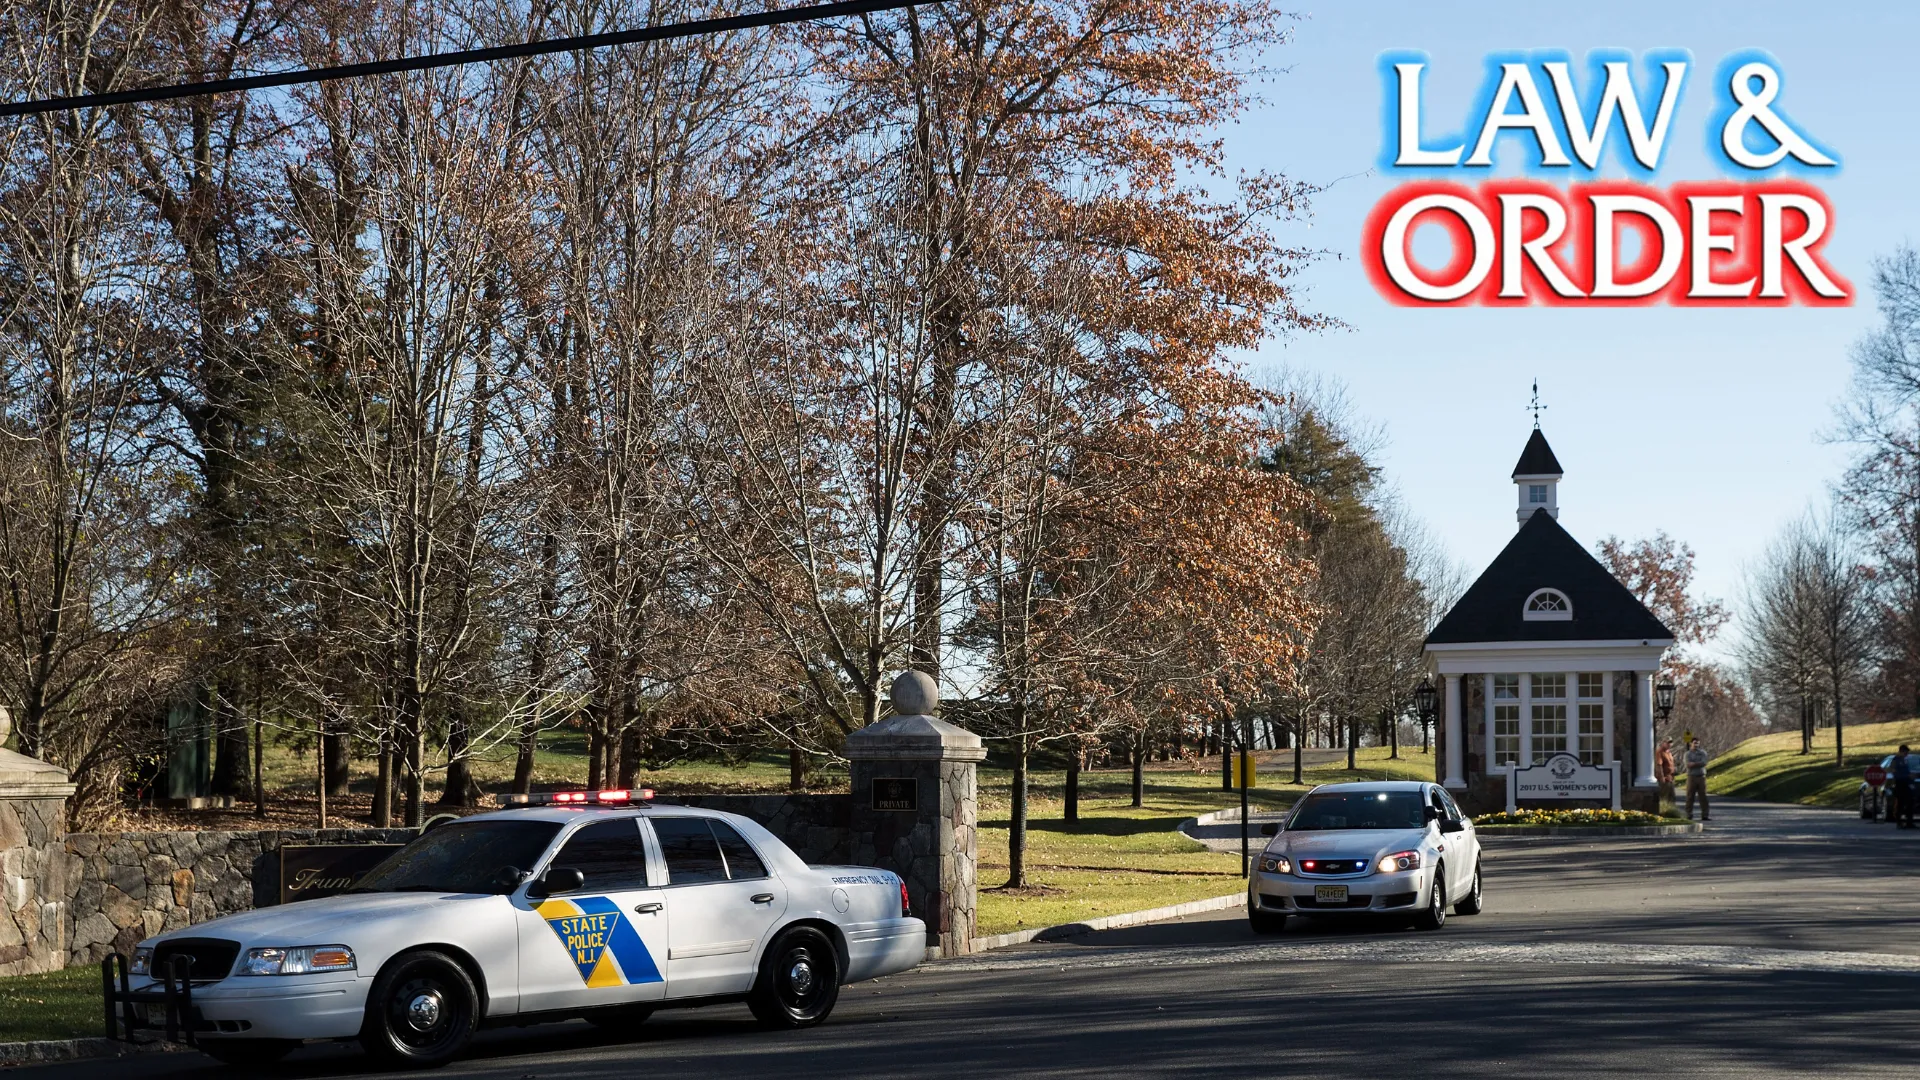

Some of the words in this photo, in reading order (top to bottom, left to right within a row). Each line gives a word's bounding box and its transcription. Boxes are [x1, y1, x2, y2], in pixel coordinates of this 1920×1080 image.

[879, 800, 910, 809] PRIVATE
[288, 868, 353, 891] Trum
[561, 916, 608, 935] STATE
[567, 932, 605, 950] POLICE
[577, 949, 596, 964] N.J.
